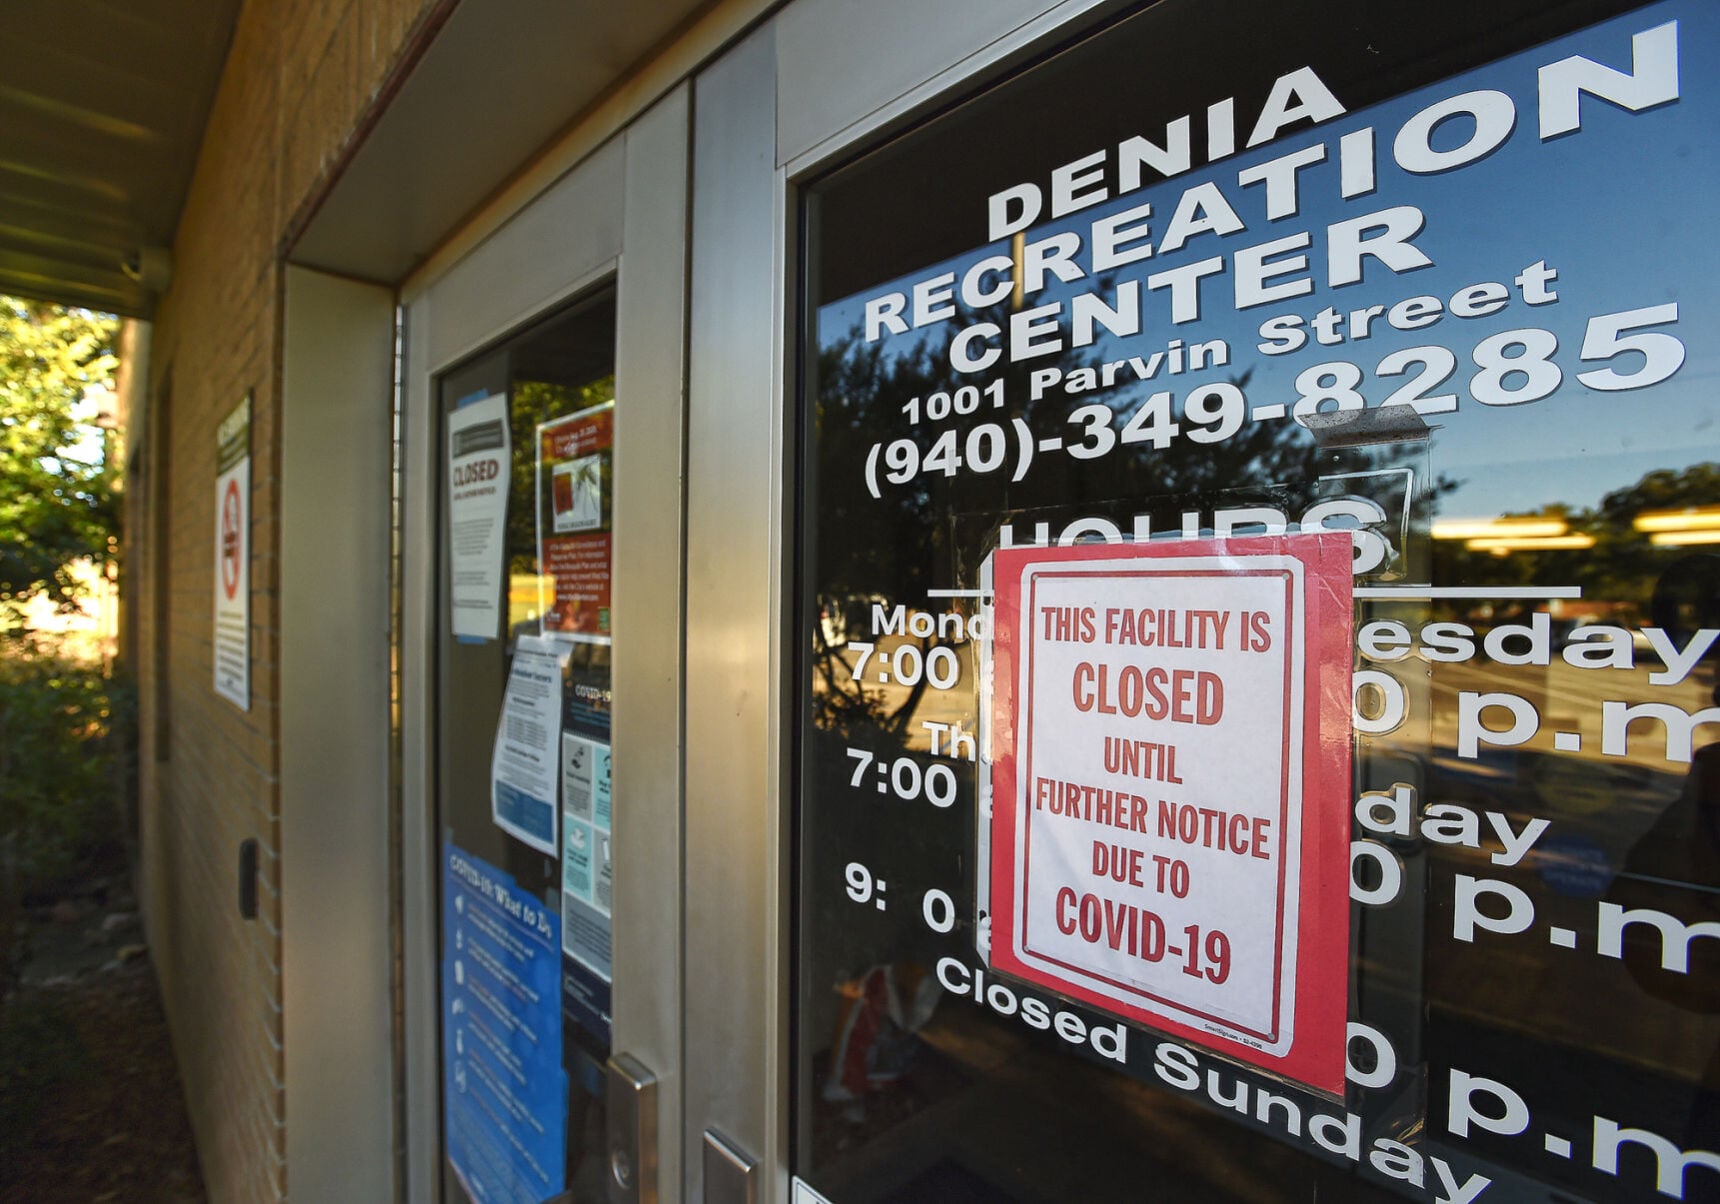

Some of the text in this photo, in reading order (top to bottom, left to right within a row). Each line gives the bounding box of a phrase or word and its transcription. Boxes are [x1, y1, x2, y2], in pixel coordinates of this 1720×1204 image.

[865, 20, 1680, 342] RECREATION
[989, 66, 1346, 242] DENIA
[949, 205, 1435, 373] CENTER
[902, 260, 1557, 425] 1001 Parvin Street
[865, 302, 1685, 499] (940)-349-8285
[453, 459, 500, 487] CLOSED
[848, 642, 960, 690] 7:00
[1041, 607, 1271, 652] THIS FACILITY IS
[1073, 662, 1224, 725] CLOSED
[847, 747, 957, 808] 7:00
[1104, 736, 1183, 784] UNTIL
[1036, 777, 1148, 833] FURTHER
[1158, 800, 1270, 859] NOTICE
[1092, 840, 1189, 898] DUE TO
[1056, 886, 1231, 984] COVID-19
[936, 957, 1492, 1204] Closed Sunday
